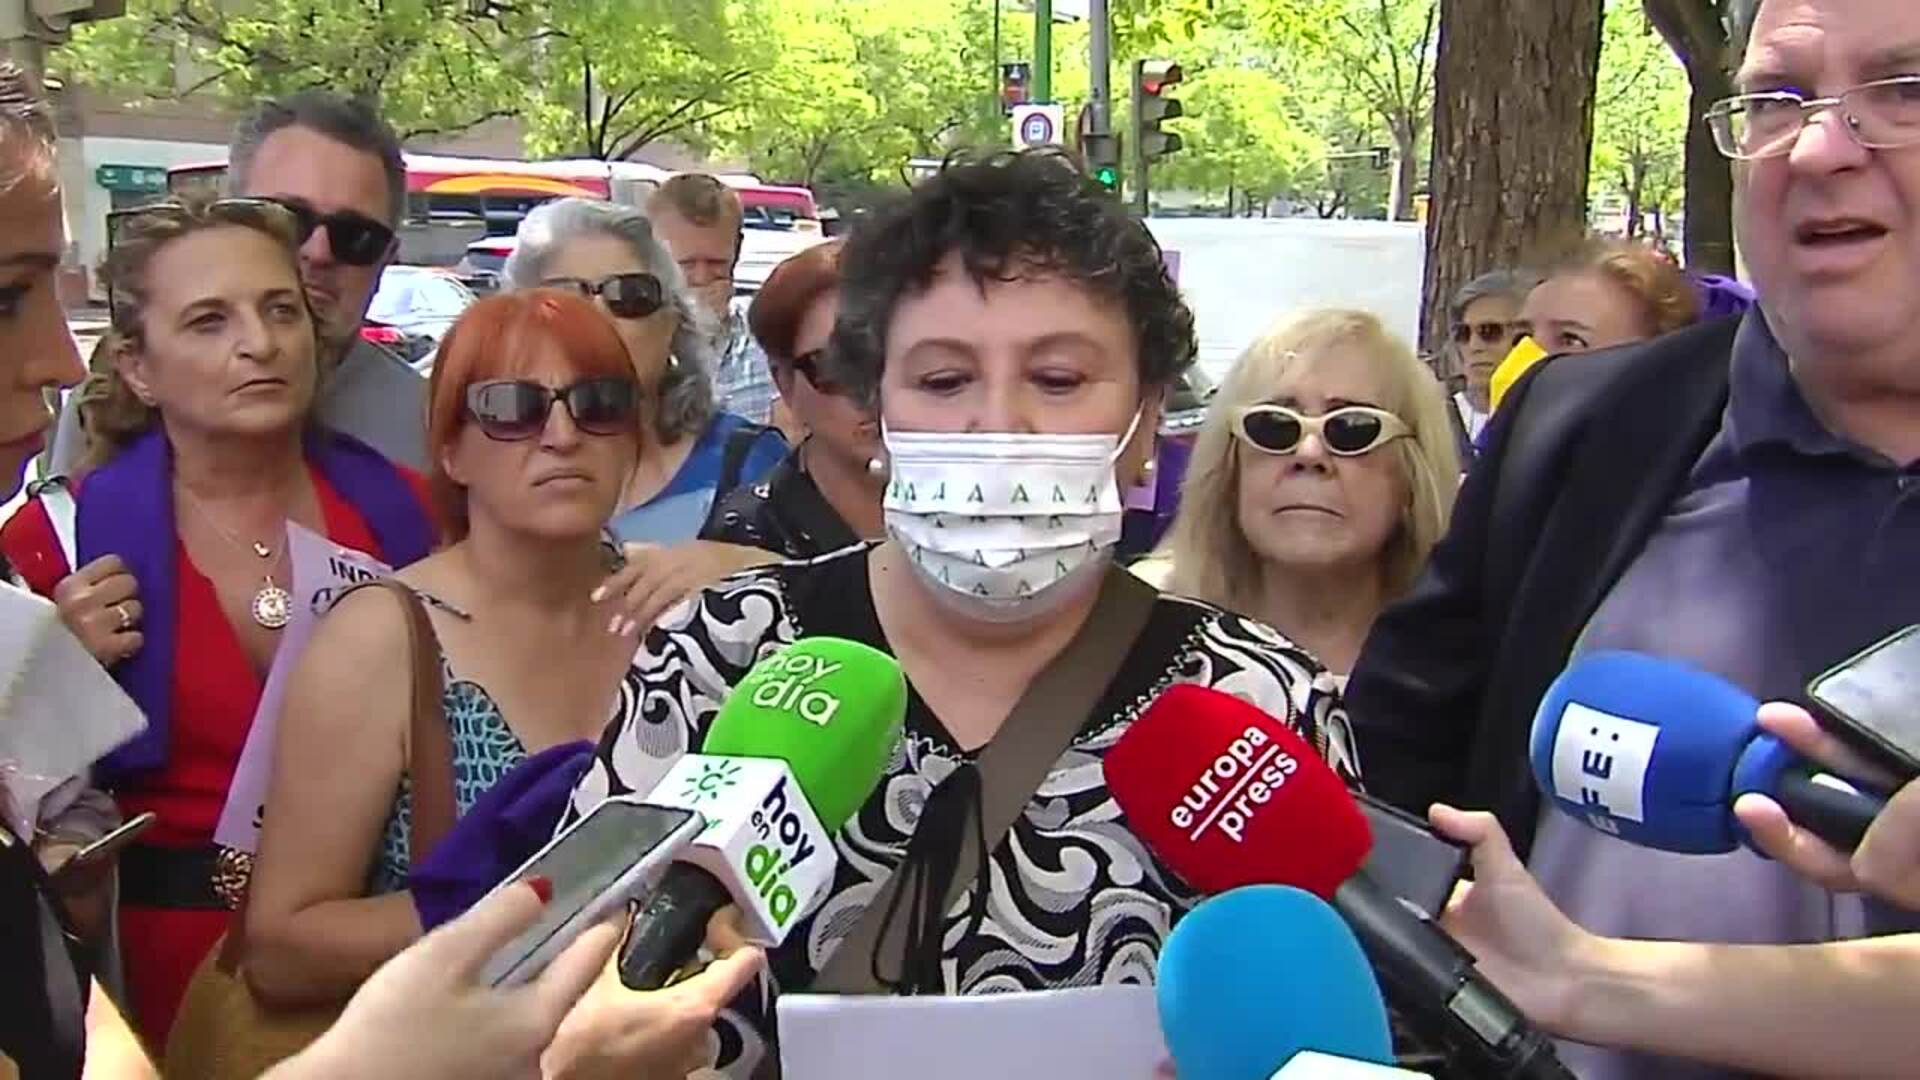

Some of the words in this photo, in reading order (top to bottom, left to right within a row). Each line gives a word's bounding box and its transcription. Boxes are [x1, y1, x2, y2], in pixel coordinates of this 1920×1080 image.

[329, 557, 380, 583] IND
[1171, 726, 1269, 828] europa
[1217, 753, 1298, 842] press
[751, 811, 770, 840] en
[762, 775, 815, 867] hoy
[745, 844, 797, 927] día
